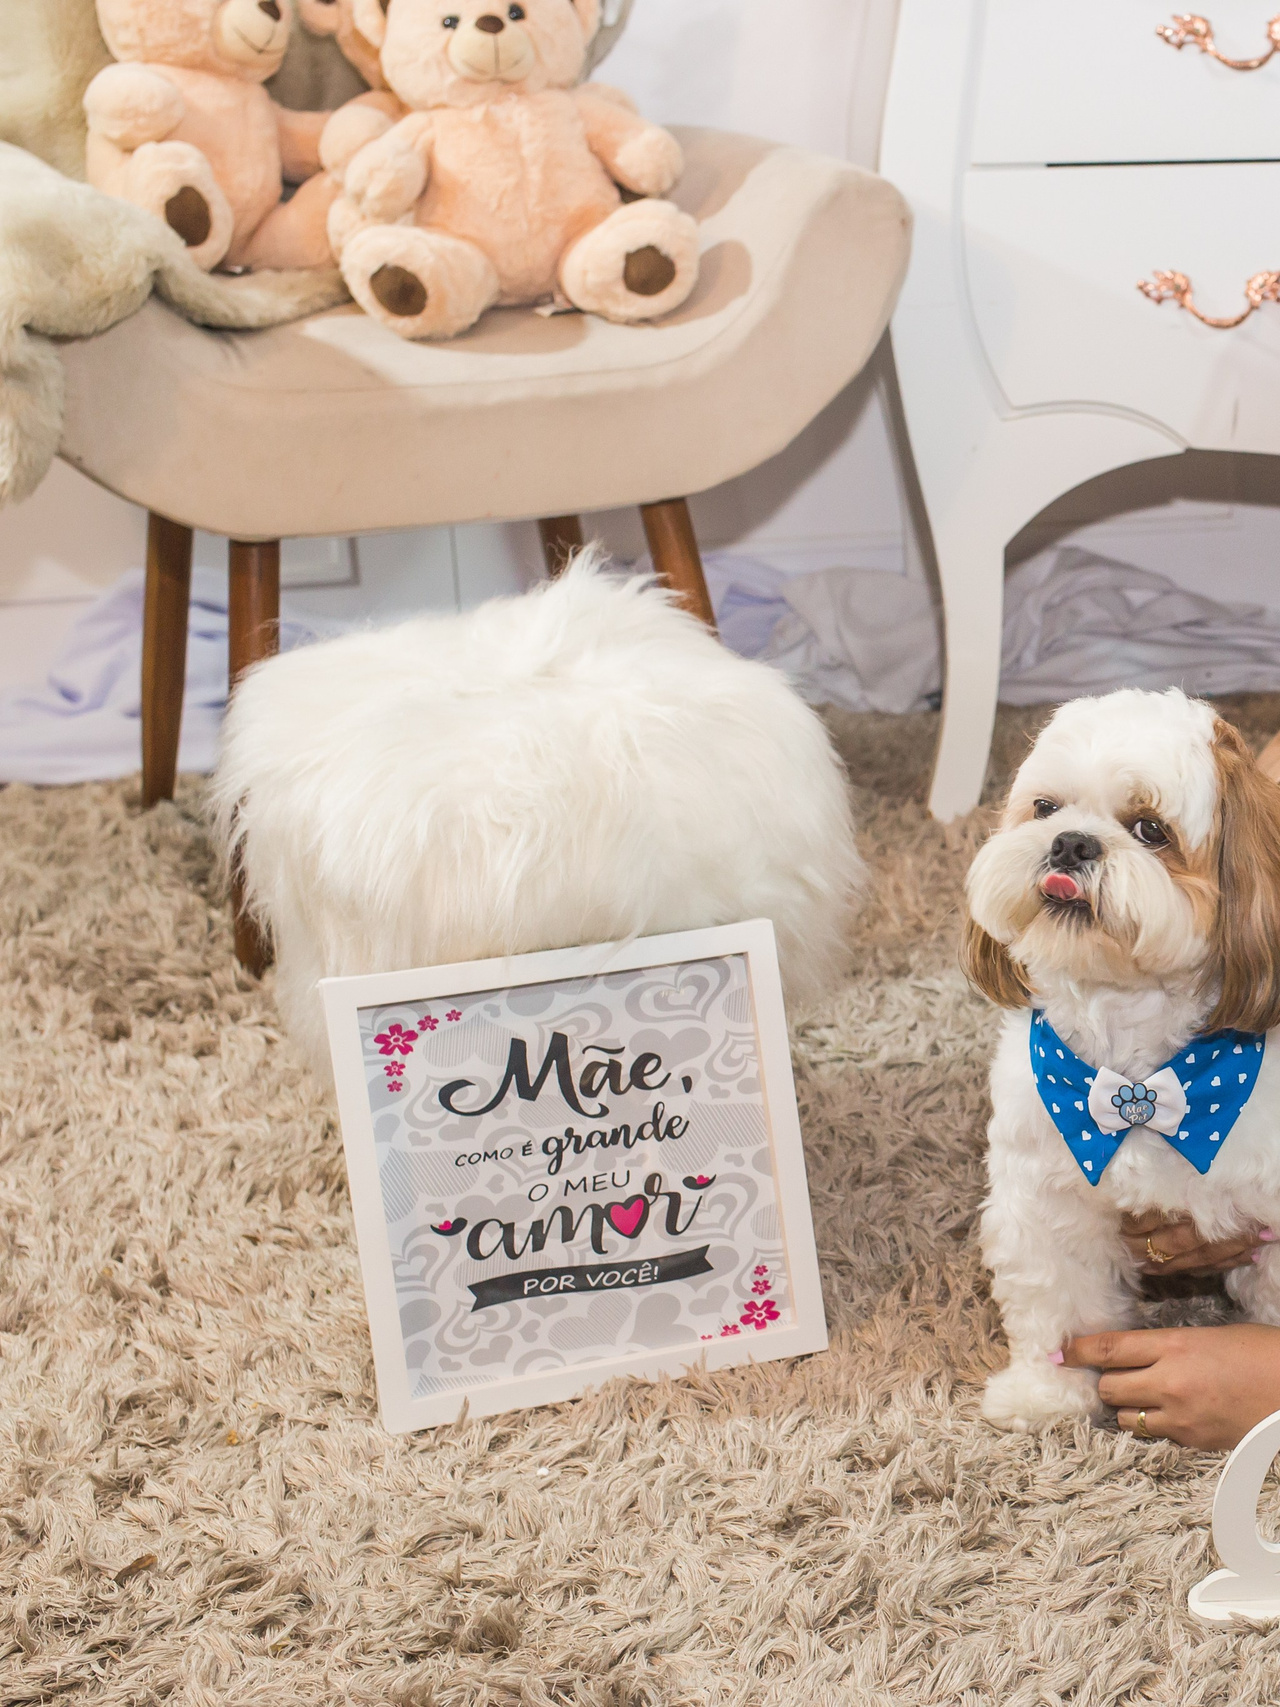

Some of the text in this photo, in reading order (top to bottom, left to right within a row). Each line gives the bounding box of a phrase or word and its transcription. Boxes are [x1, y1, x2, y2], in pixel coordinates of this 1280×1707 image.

[438, 1031, 693, 1118] Mãe,
[454, 1101, 690, 1176] COMO É grande
[1129, 1113, 1148, 1125] Pet
[528, 1170, 631, 1203] O MEU
[467, 1173, 703, 1261] amor
[523, 1262, 660, 1295] POR VOCÊ!
